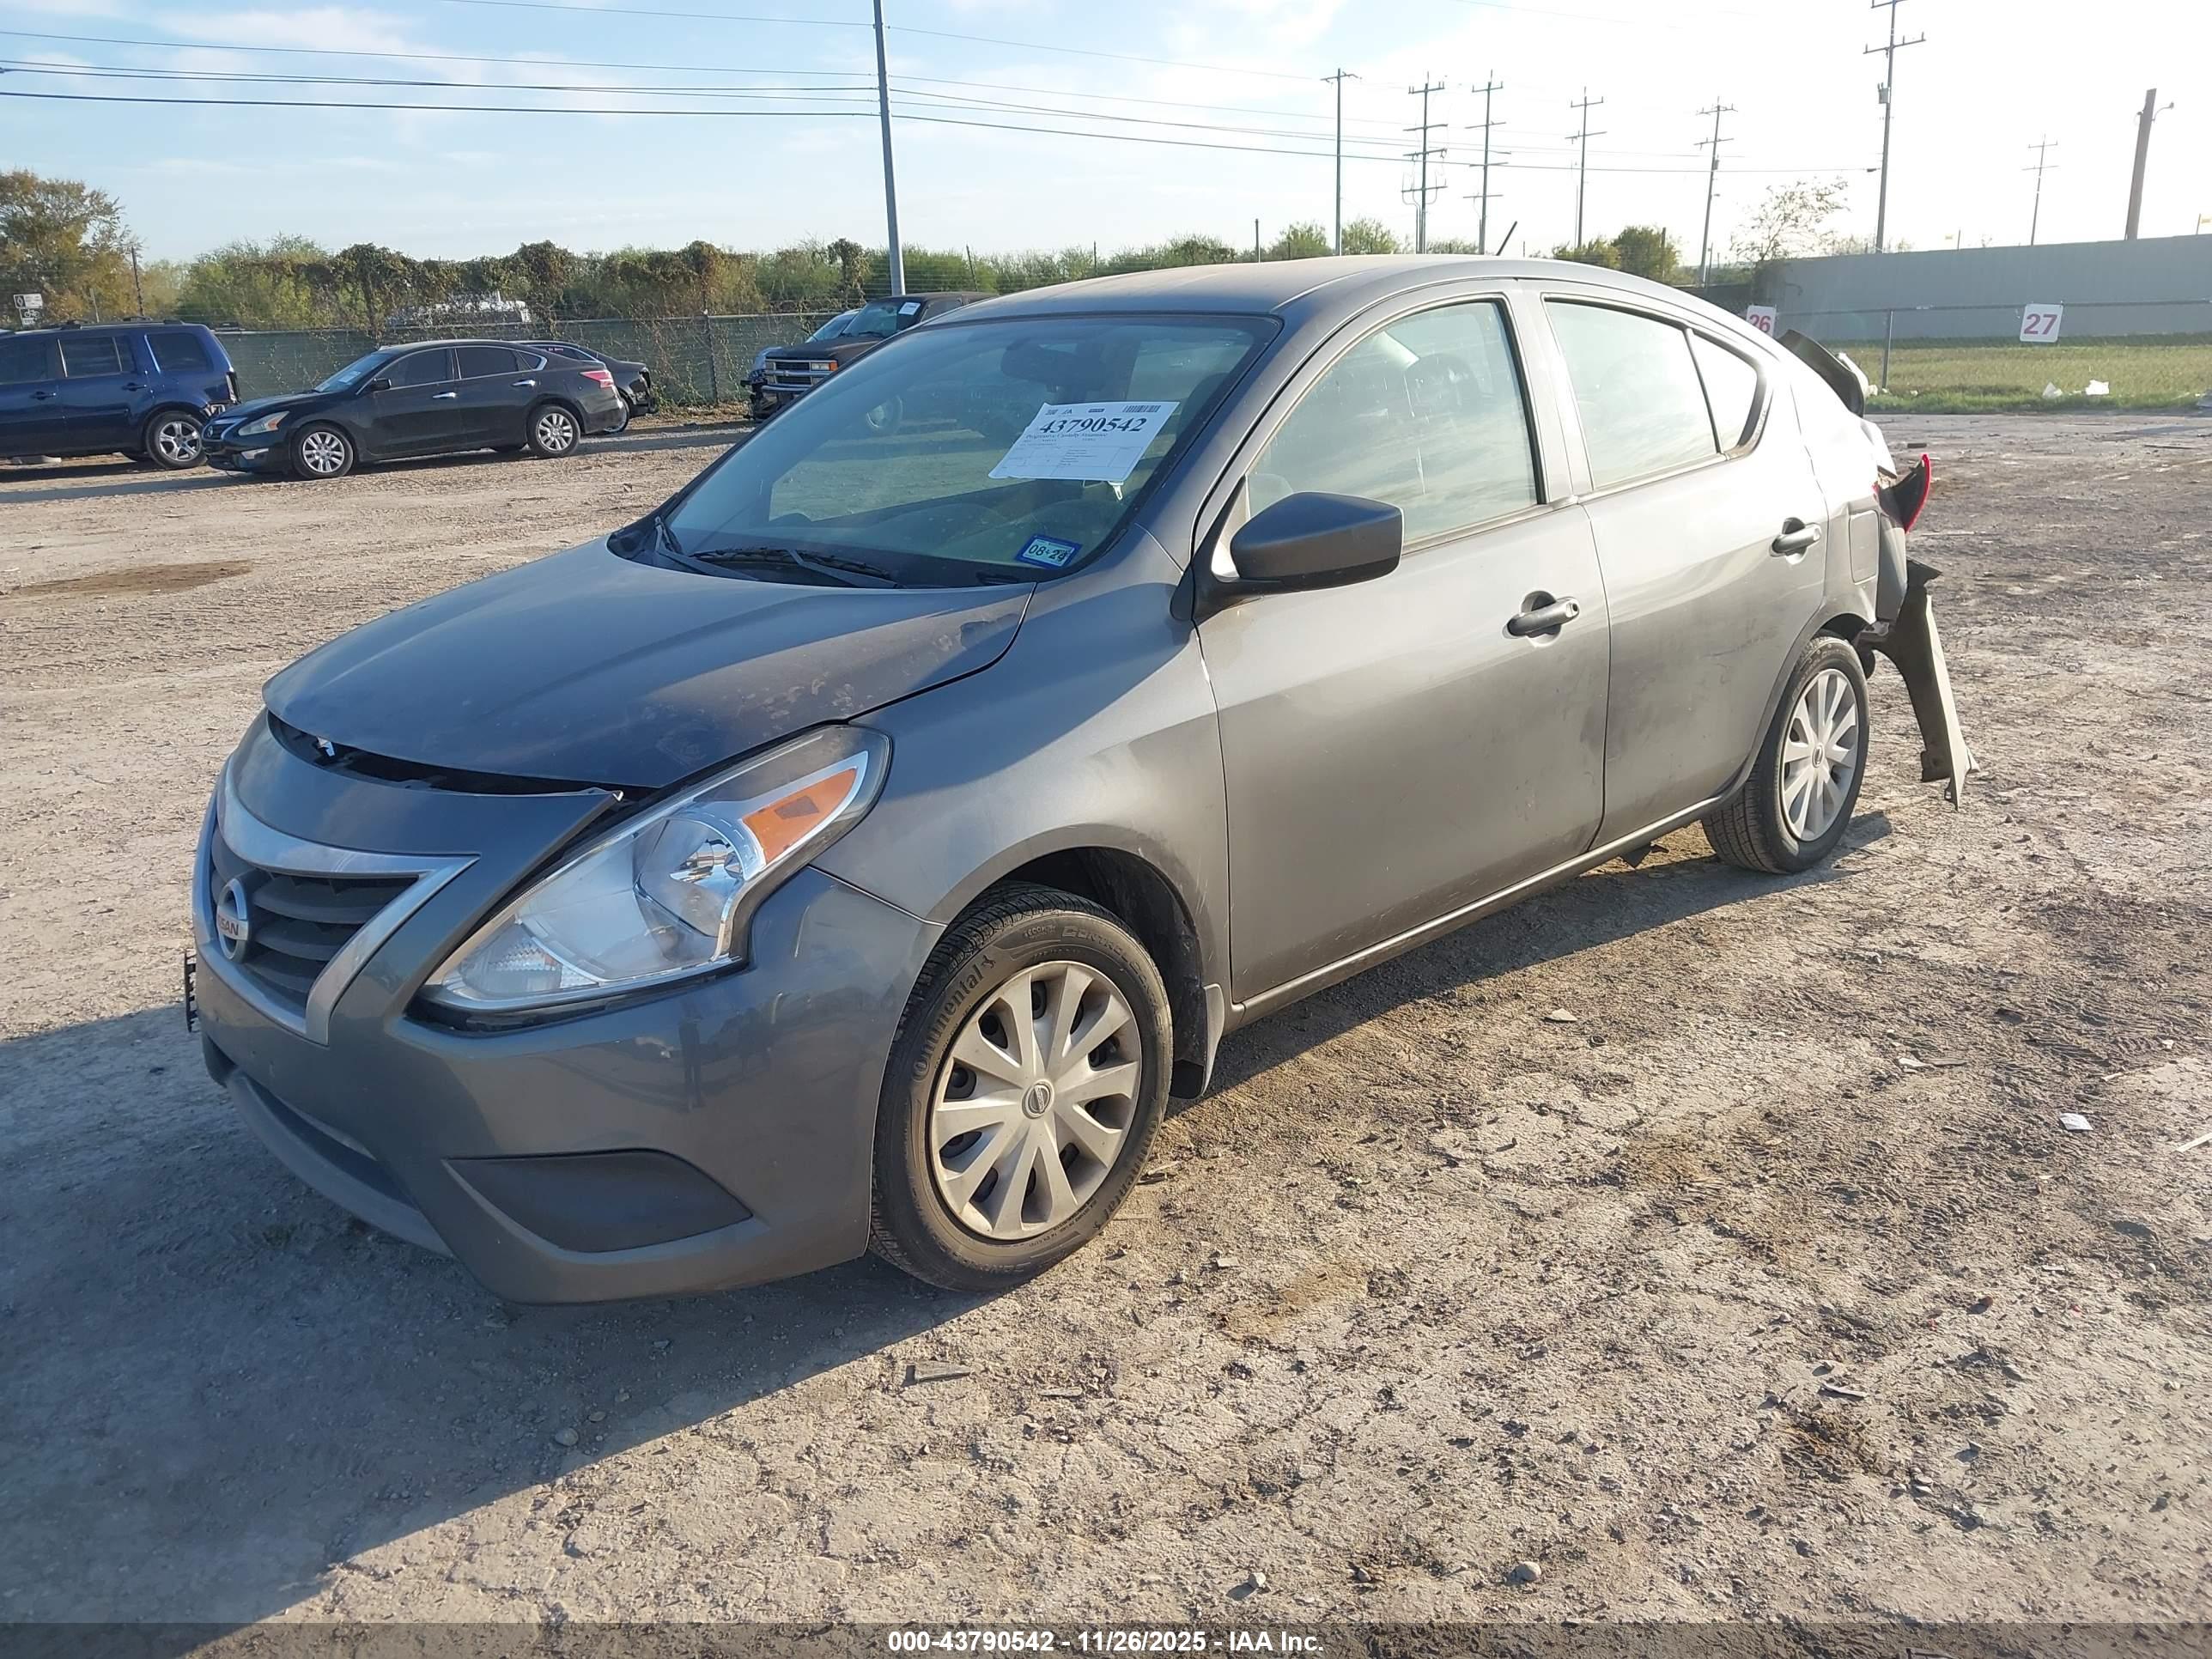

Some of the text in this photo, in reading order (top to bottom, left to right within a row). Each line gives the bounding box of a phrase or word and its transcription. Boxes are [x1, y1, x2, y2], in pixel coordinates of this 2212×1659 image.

[1749, 314, 1771, 333] 26
[2024, 313, 2058, 335] 27
[1040, 417, 1147, 434] 43790542
